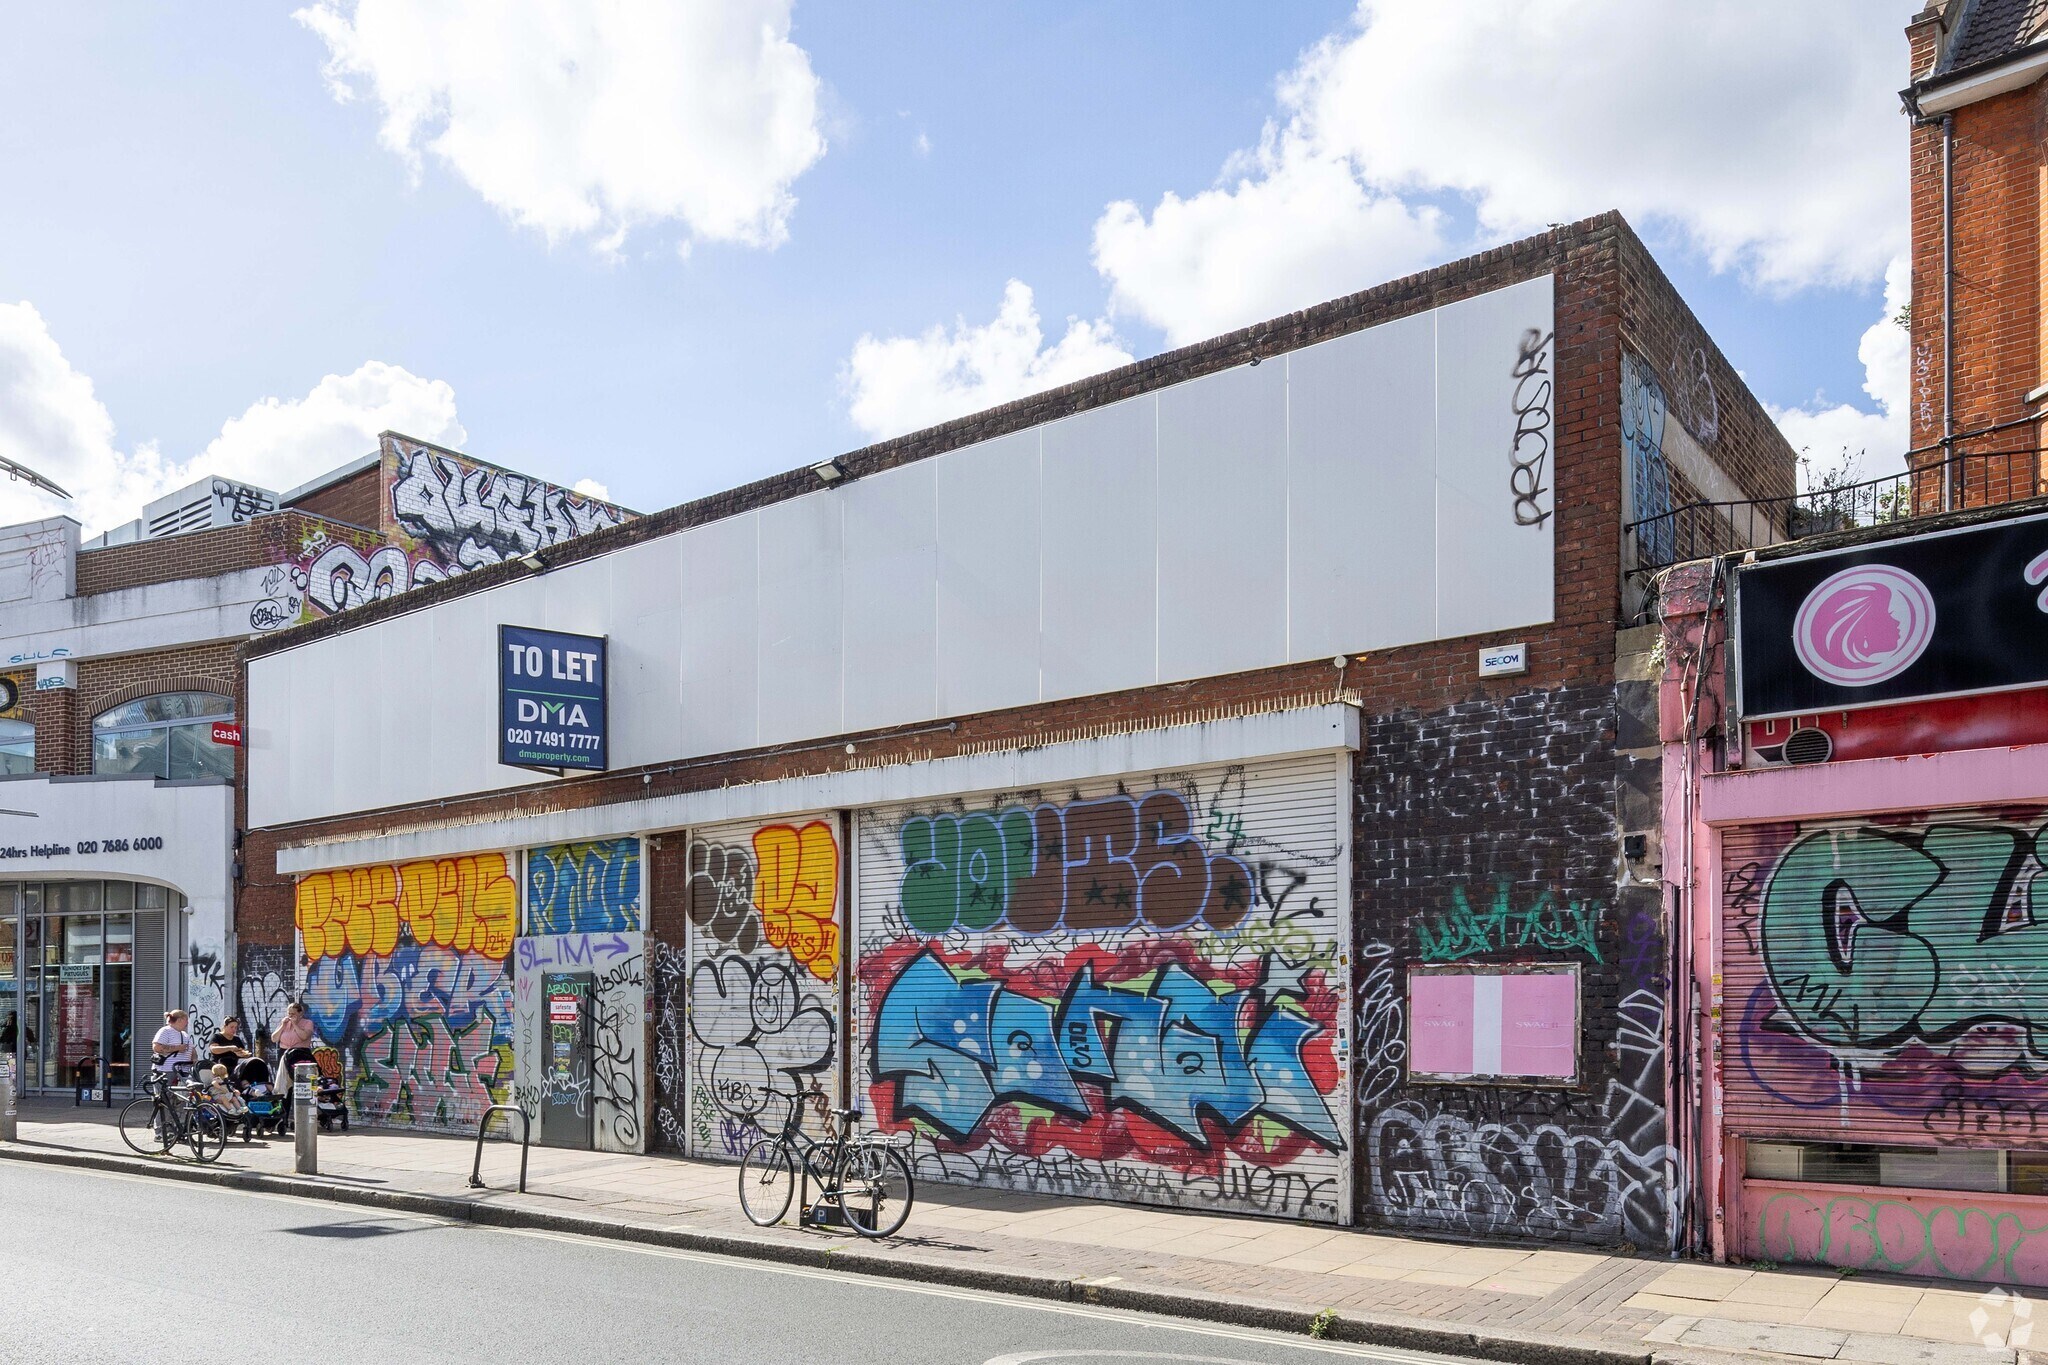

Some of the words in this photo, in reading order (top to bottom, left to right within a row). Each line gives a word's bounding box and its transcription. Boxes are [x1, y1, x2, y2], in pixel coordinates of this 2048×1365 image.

[508, 644, 543, 677] TO
[552, 649, 597, 682] LET
[1485, 654, 1519, 667] SECOM
[518, 698, 589, 728] DMA
[213, 728, 240, 742] cash
[507, 728, 532, 745] 020
[534, 730, 565, 747] 7491
[569, 733, 600, 750] 7777
[518, 749, 590, 763] dmaproperty.com
[0, 846, 28, 859] 24hrs
[30, 843, 71, 859] Helpline
[76, 841, 98, 854] 020
[101, 839, 129, 853] 7686
[133, 836, 163, 851] 6000
[519, 933, 594, 972] SLIM
[1424, 1020, 1455, 1028] SWAG
